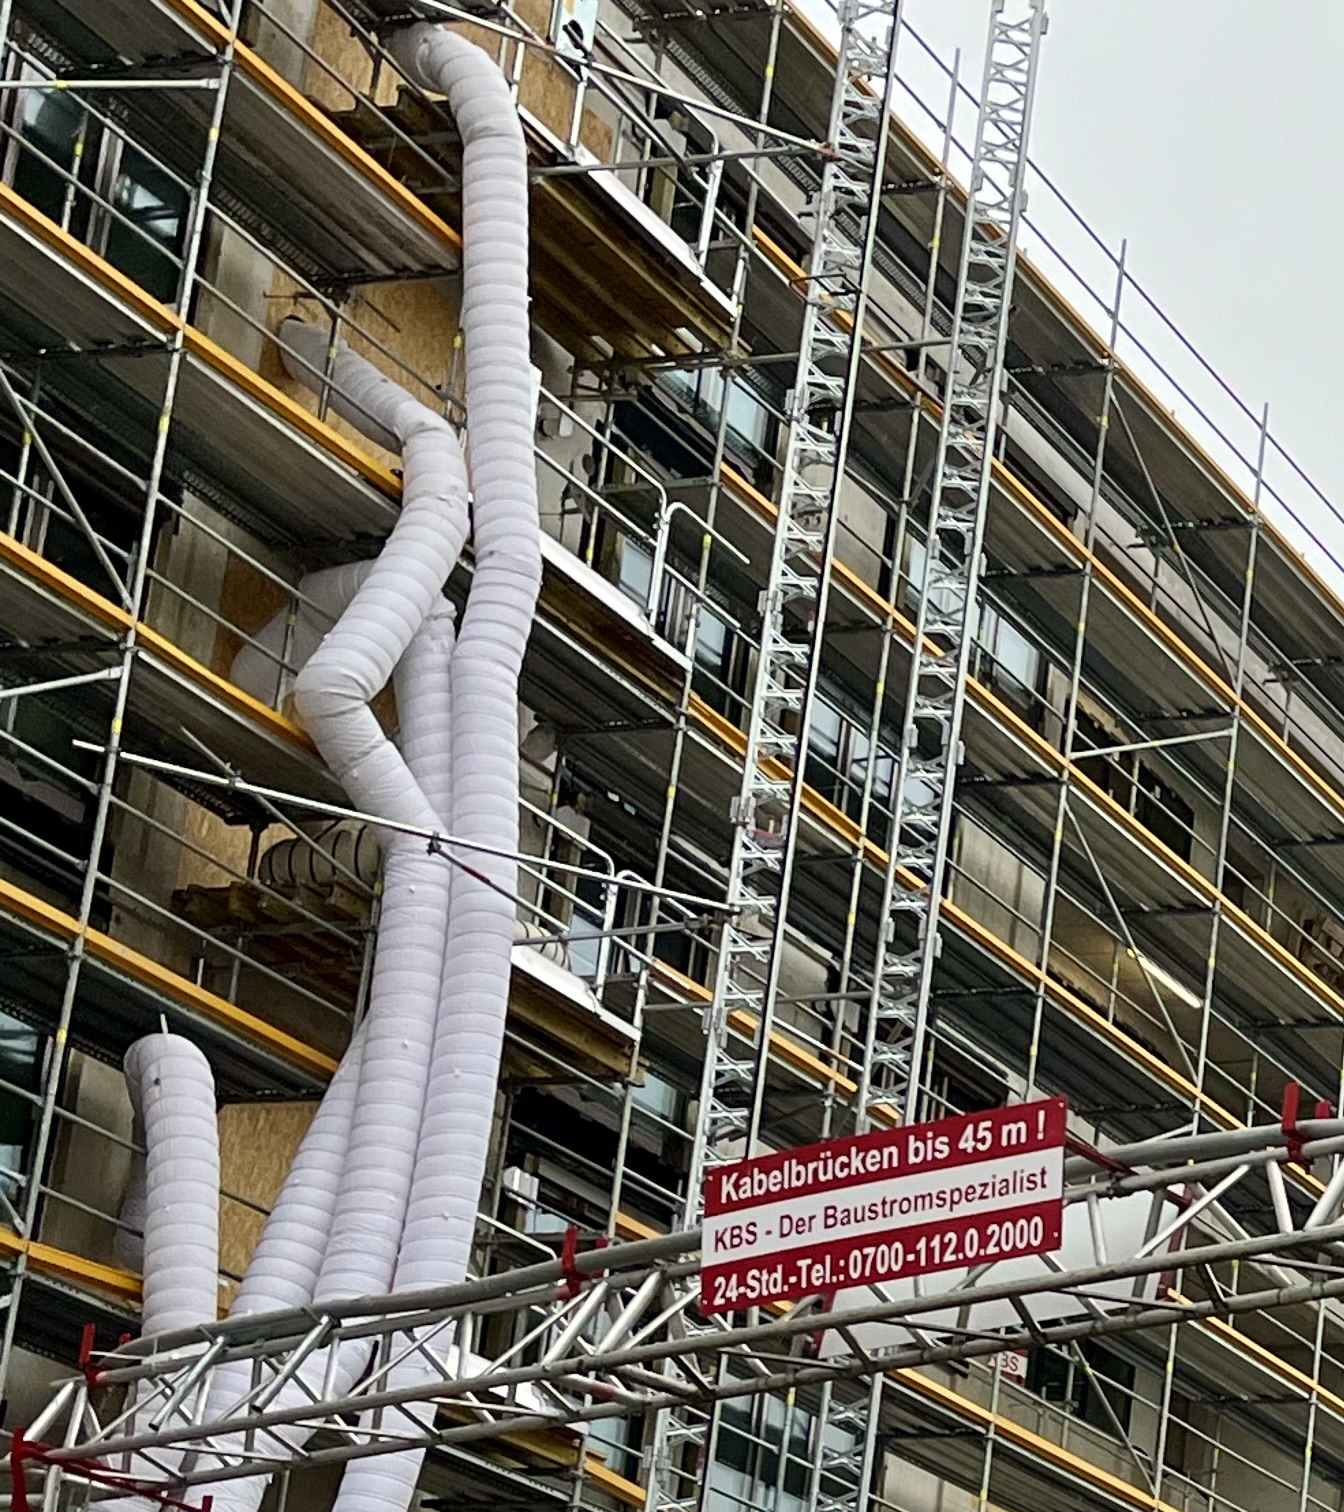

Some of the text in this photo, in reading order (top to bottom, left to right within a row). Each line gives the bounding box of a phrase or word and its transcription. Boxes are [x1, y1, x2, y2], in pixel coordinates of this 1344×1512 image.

[721, 1109, 1046, 1204] Kabelbrücken bis 45 m !
[714, 1220, 758, 1253] KBS
[779, 1208, 817, 1240] Der
[823, 1166, 1048, 1230] Baustromspezialist
